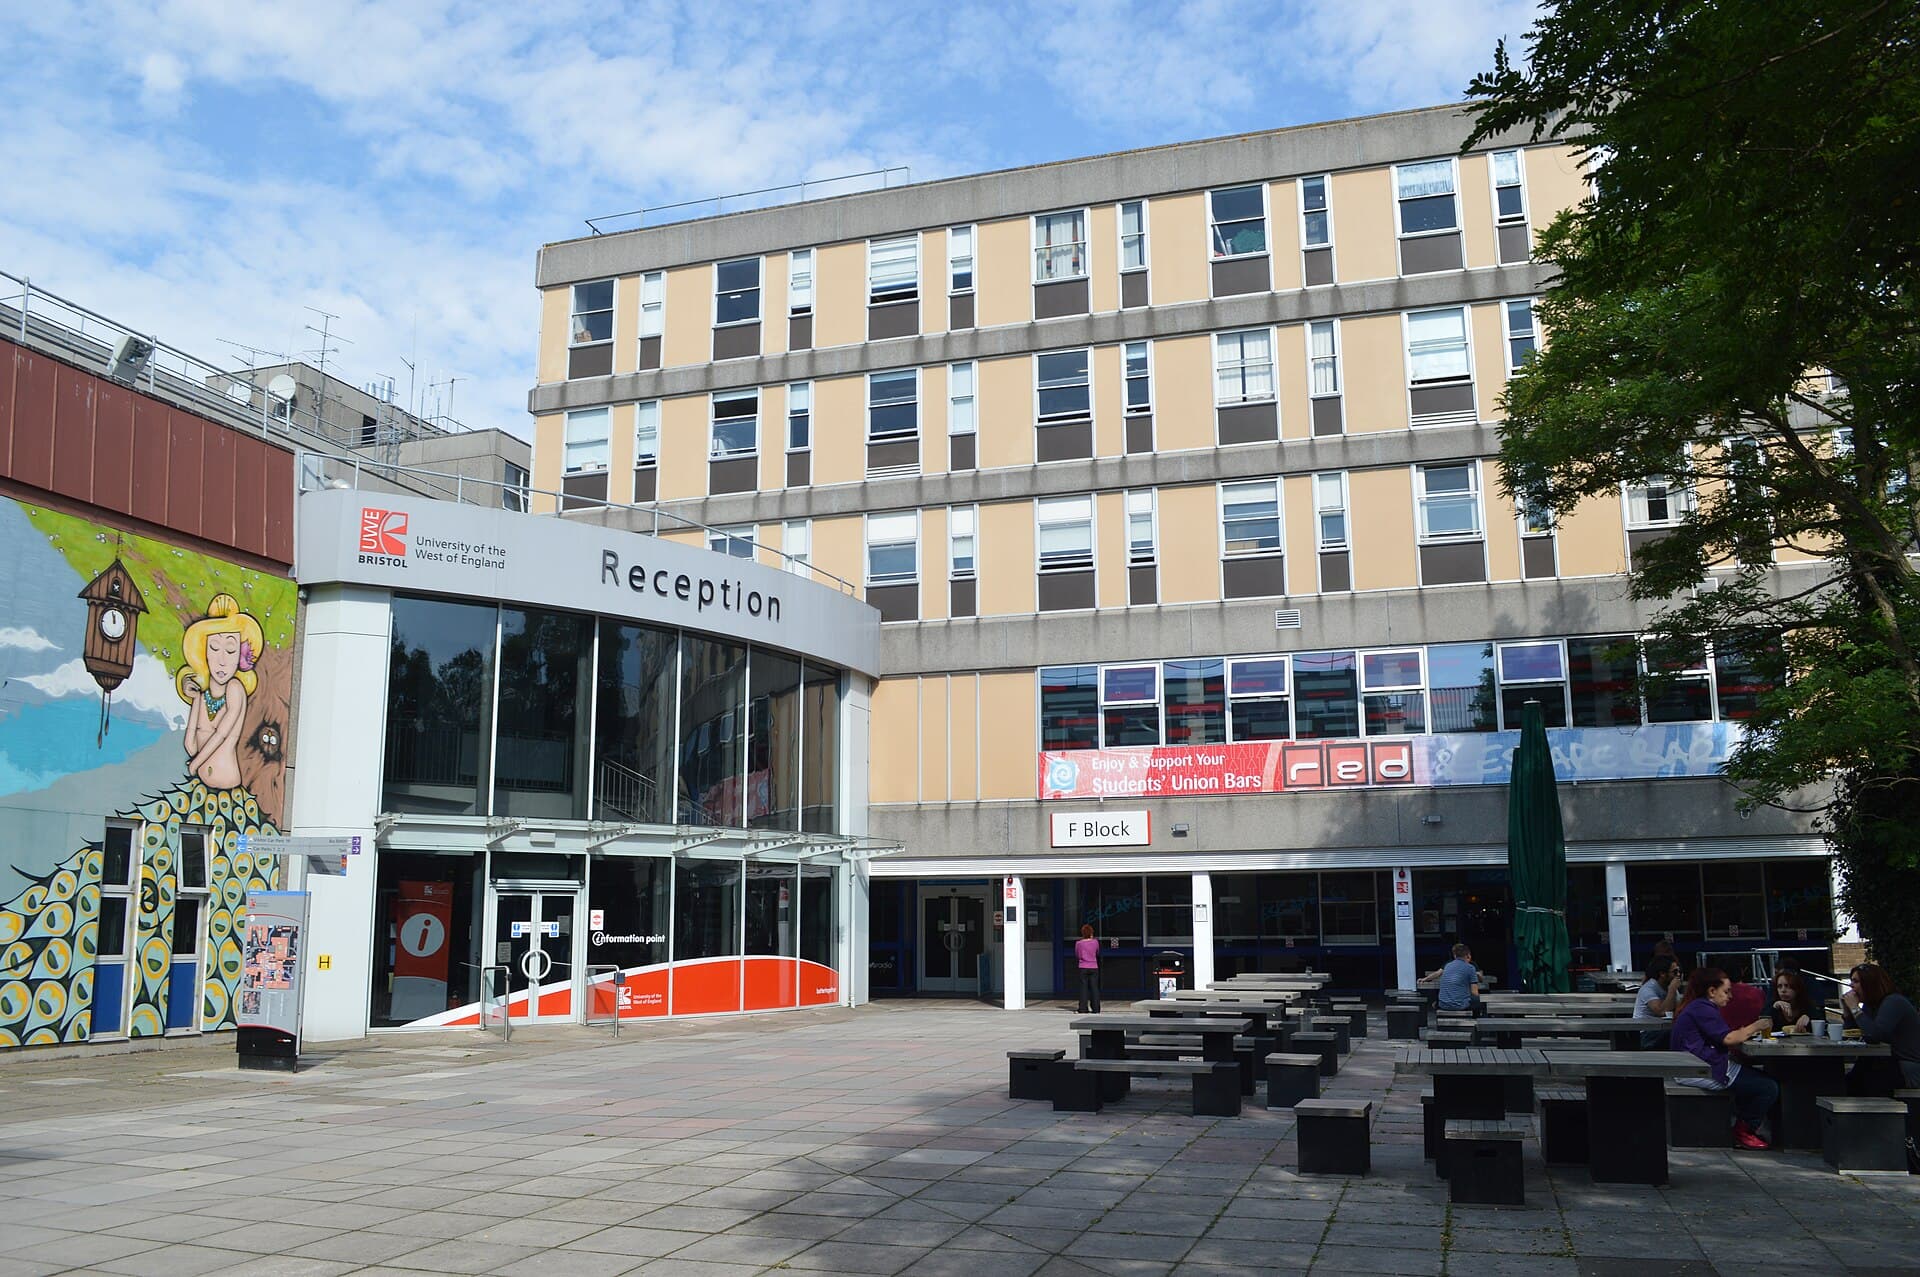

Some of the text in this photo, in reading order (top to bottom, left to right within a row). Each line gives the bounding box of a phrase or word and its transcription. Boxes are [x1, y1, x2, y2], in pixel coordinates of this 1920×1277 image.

[362, 510, 379, 549] UWE
[416, 536, 506, 556] University of the
[358, 554, 408, 568] BRISTOL
[415, 549, 505, 569] West of England
[601, 549, 781, 622] Reception
[1092, 753, 1226, 773] Enjoy & Support Your
[1287, 746, 1411, 783] red
[1171, 775, 1219, 791] Union
[1224, 773, 1262, 789] Bars
[1069, 820, 1130, 838] F Block
[592, 931, 665, 946] information point
[319, 956, 330, 969] H
